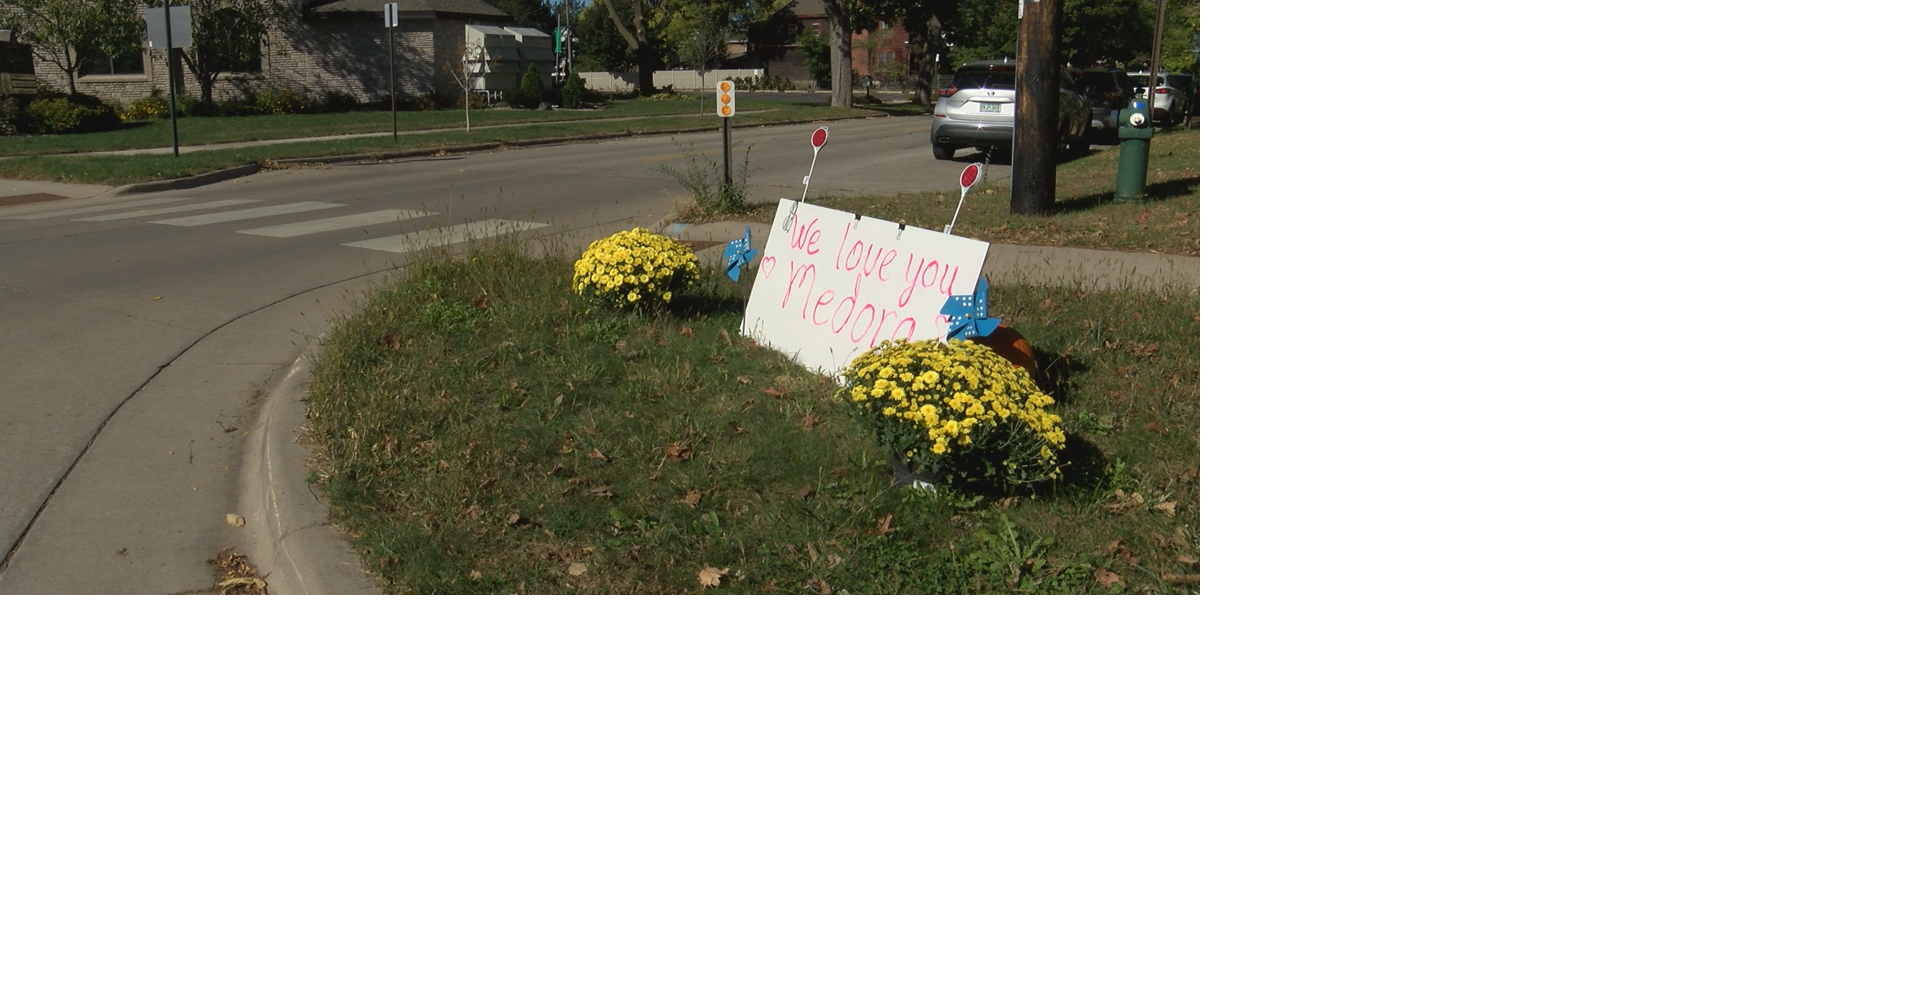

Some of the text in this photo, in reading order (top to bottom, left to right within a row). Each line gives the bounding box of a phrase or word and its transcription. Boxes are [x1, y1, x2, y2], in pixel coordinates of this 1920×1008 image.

[780, 259, 917, 350] Medora
[790, 212, 960, 310] We love you
